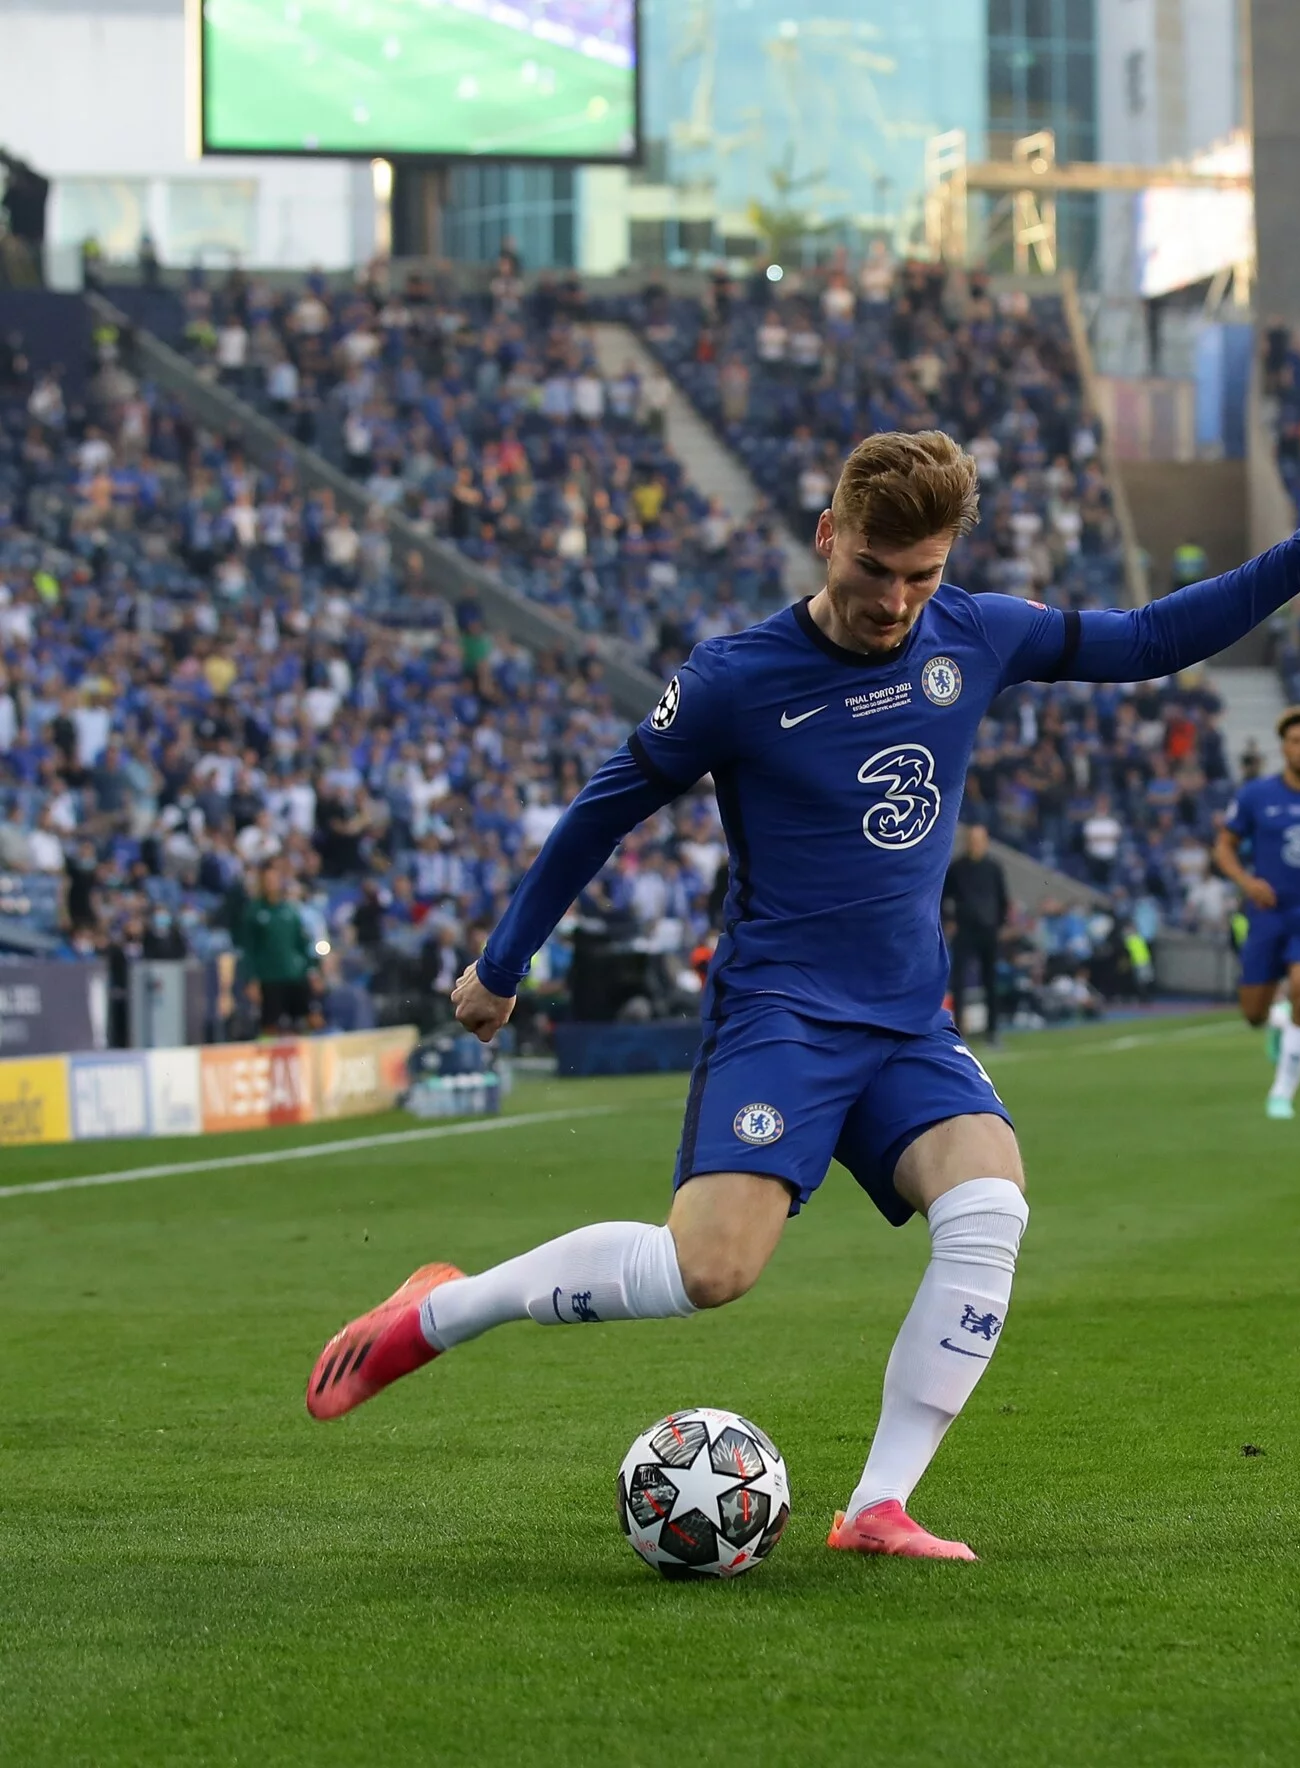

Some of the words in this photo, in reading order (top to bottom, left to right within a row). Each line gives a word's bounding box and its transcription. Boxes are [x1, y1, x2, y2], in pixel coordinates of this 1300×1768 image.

[925, 658, 950, 674] CHELSEA
[844, 694, 869, 707] FINAL
[869, 686, 895, 701] PORTO
[895, 682, 912, 694] 2021
[857, 743, 941, 850] 3
